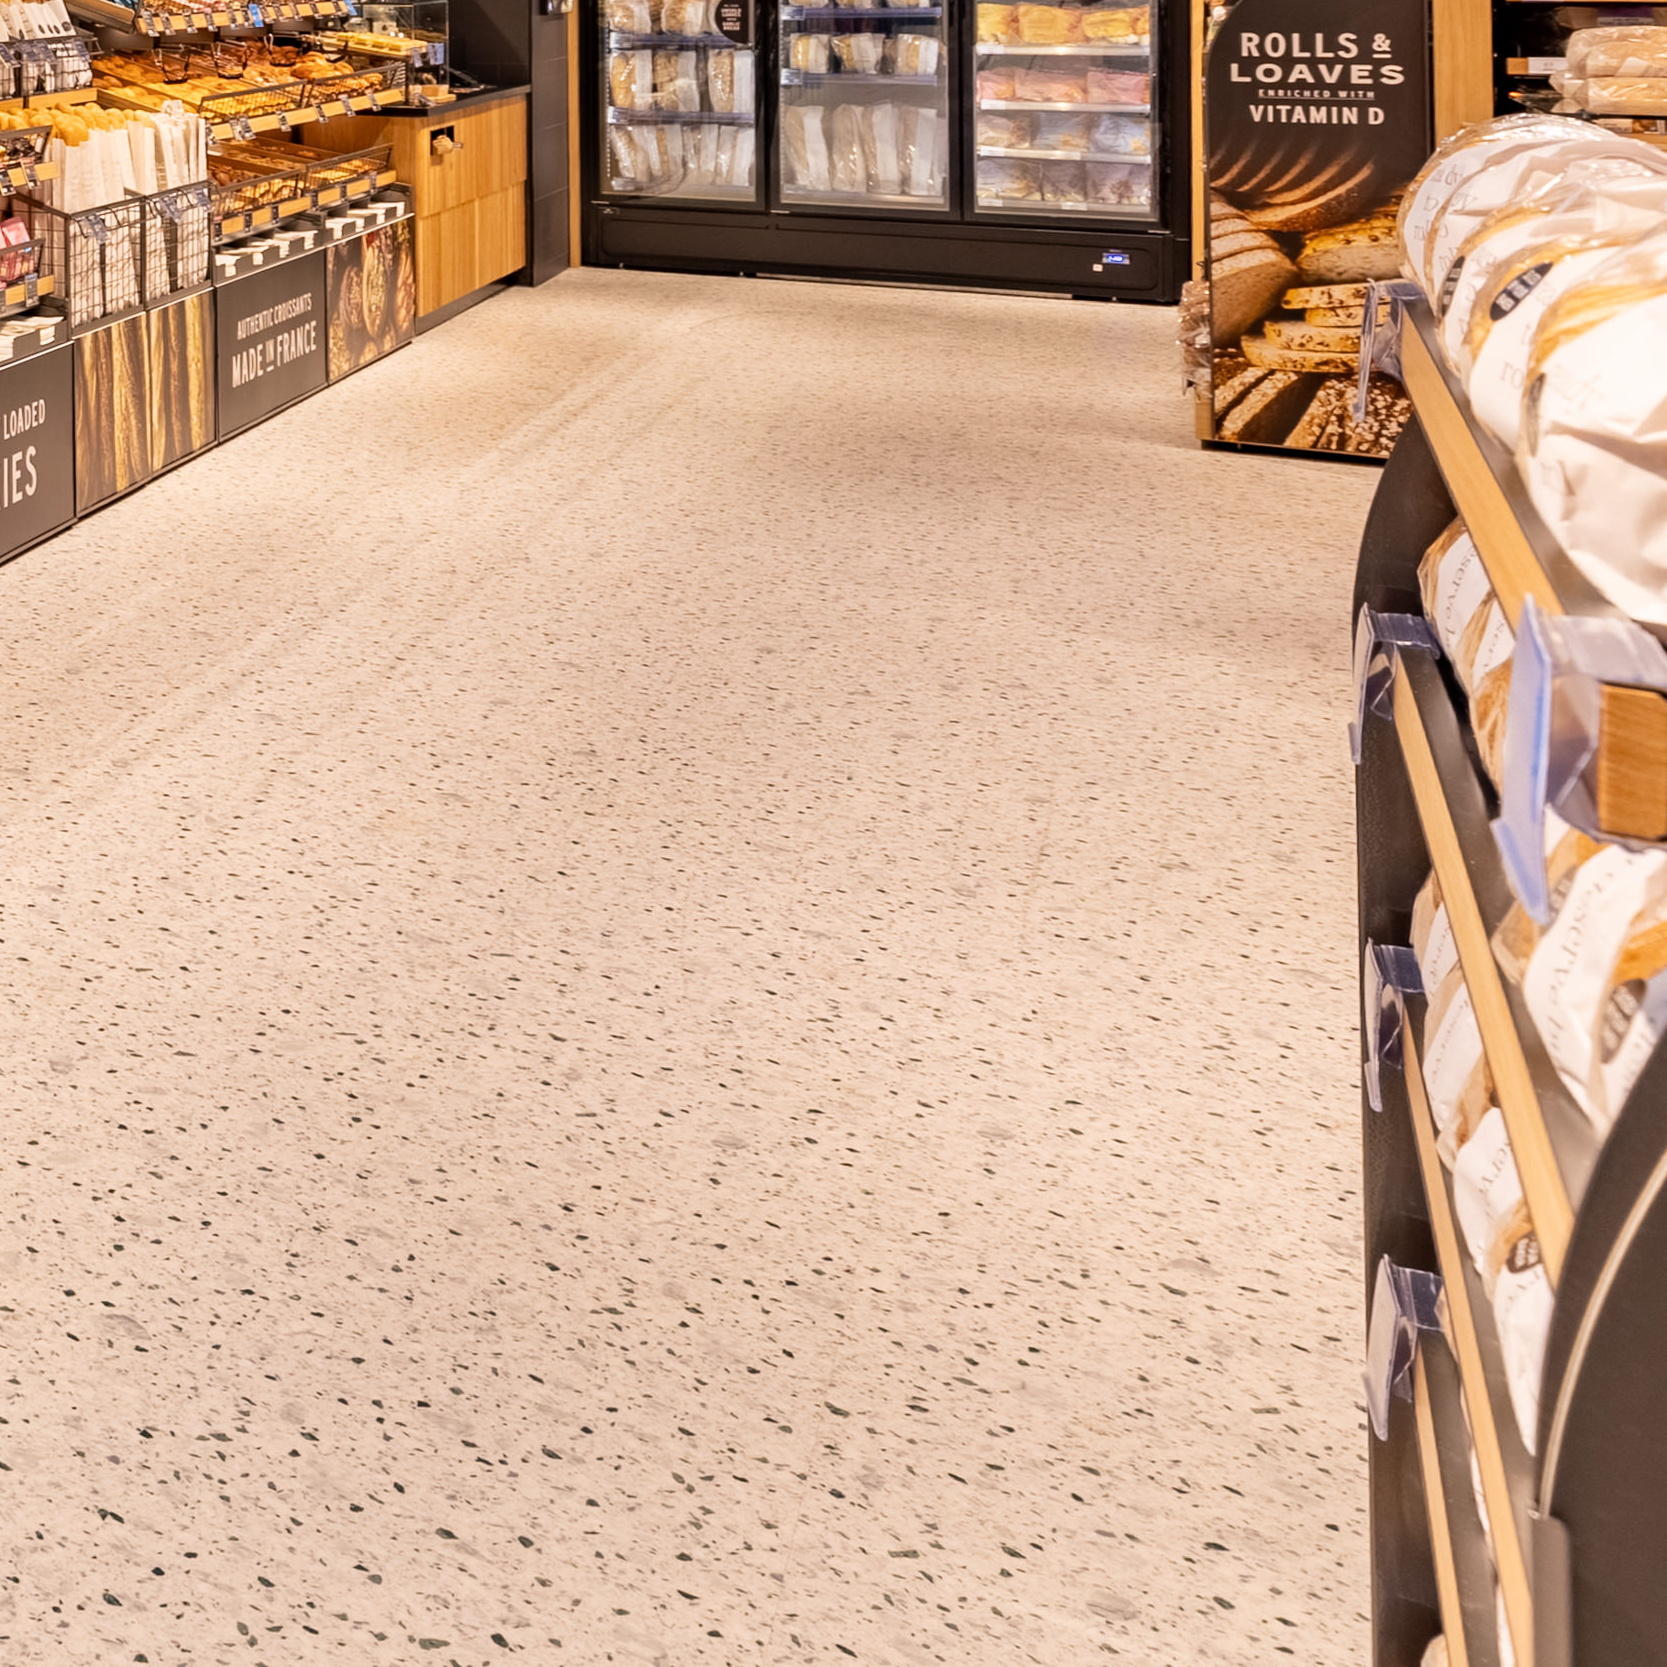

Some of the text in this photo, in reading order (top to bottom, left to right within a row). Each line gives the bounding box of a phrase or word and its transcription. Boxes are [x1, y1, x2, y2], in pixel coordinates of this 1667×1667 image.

[1240, 32, 1392, 58] ROLLS &
[1230, 64, 1406, 85] LOAVES
[1258, 89, 1375, 98] ENRICHED WITH
[1249, 105, 1385, 125] VITAMIN D
[236, 292, 313, 336] AUTHENTIC CROISSANTS
[231, 320, 317, 388] MADE IN FRANCE
[2, 399, 46, 437] LOADED
